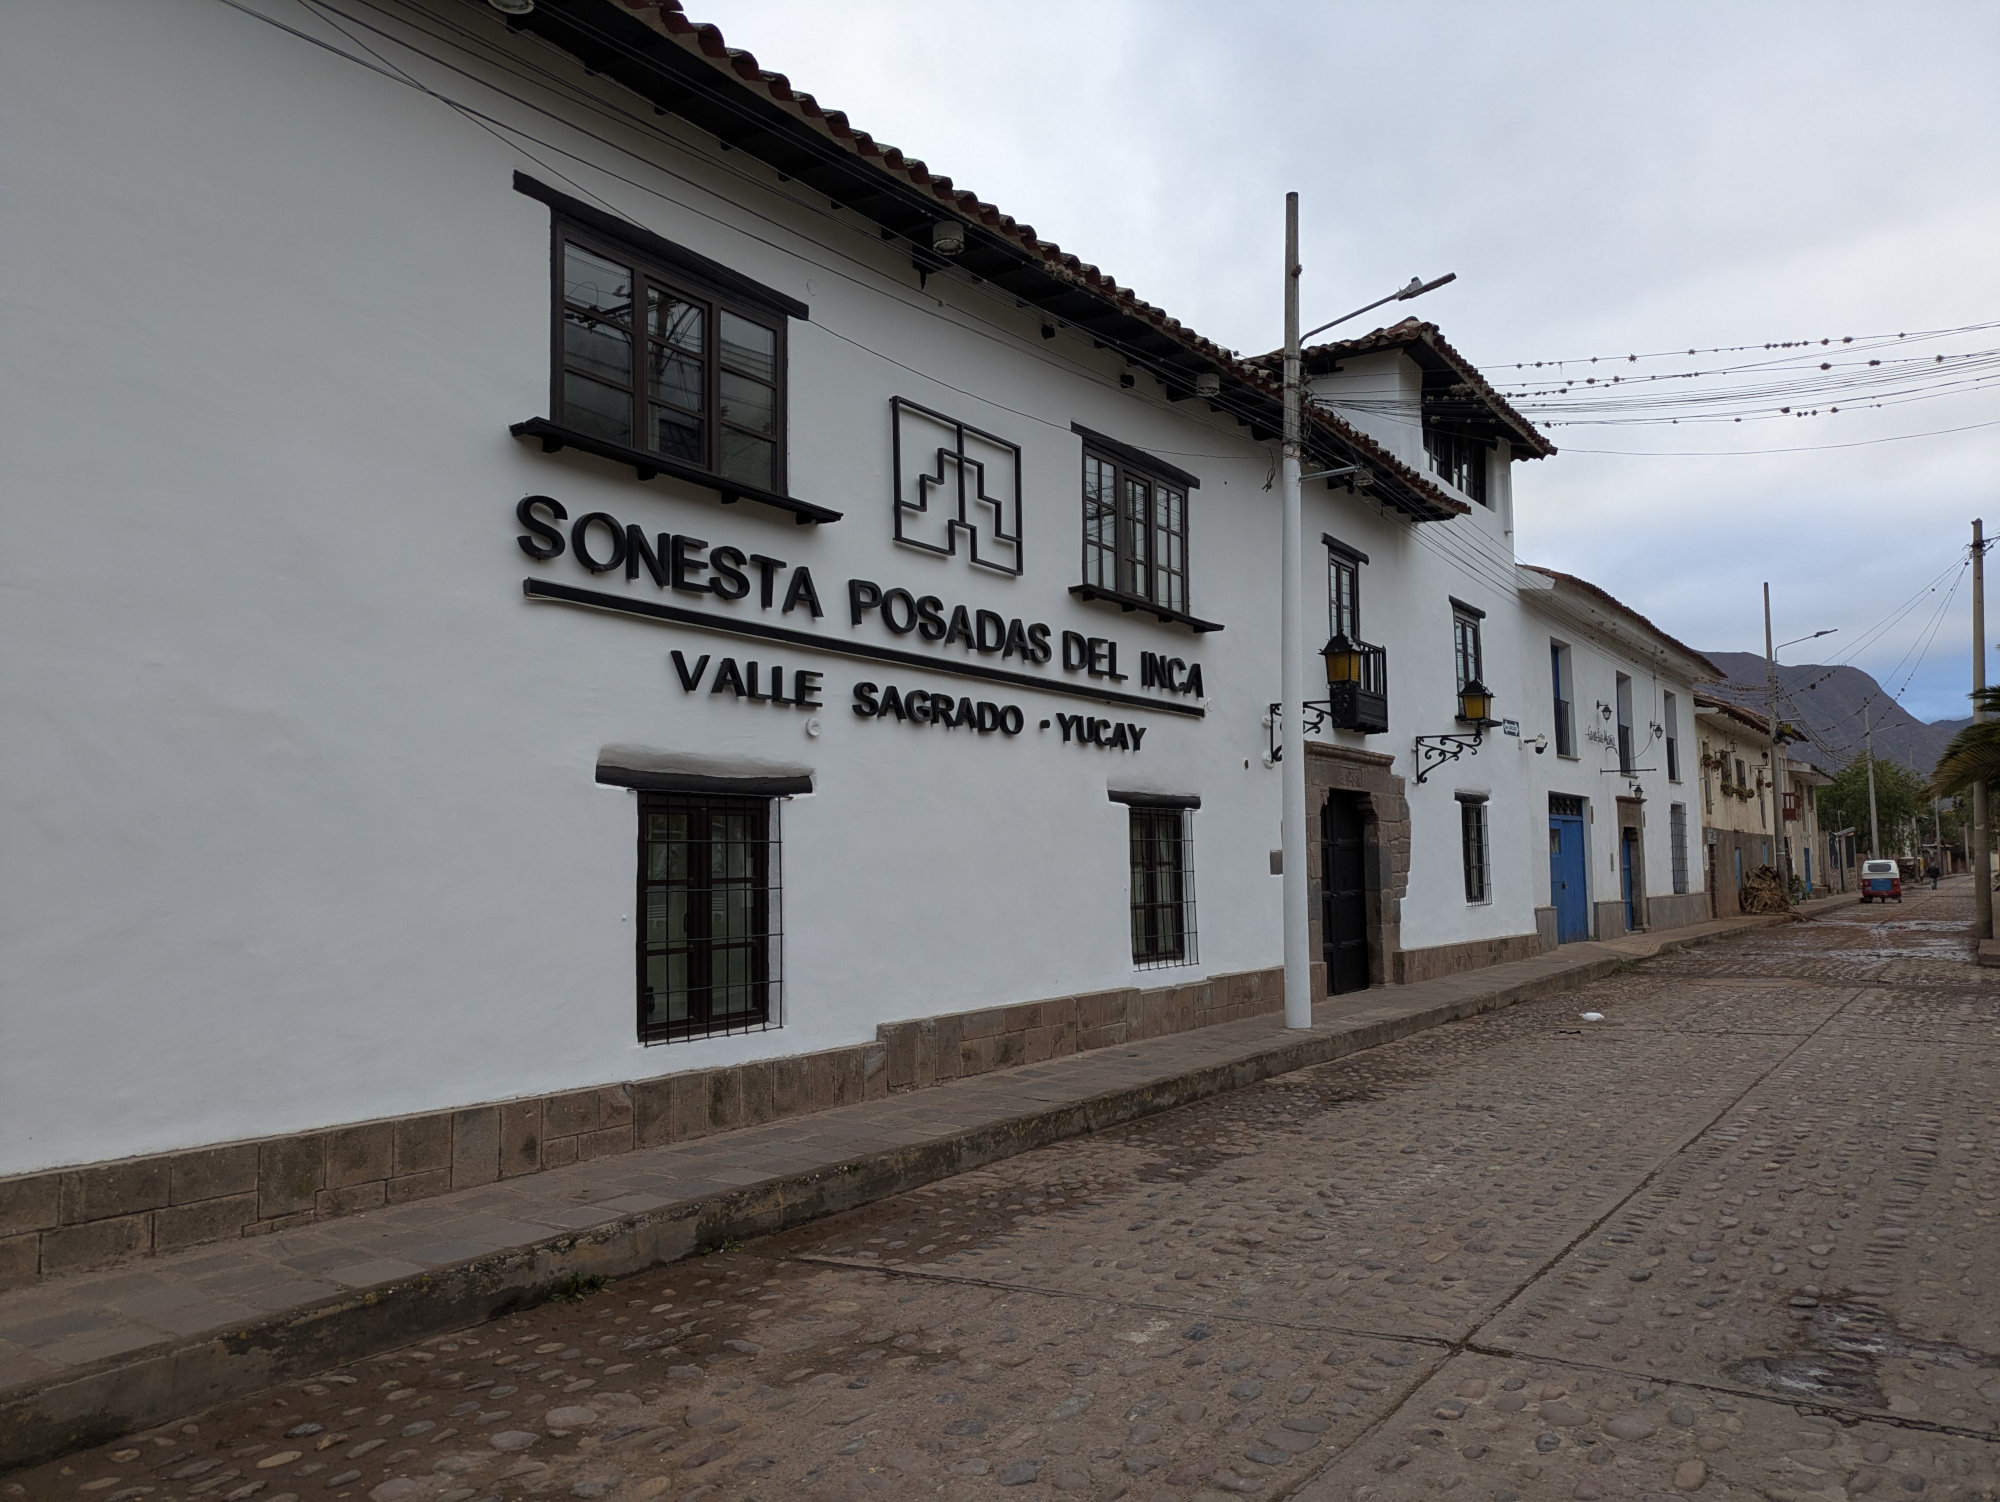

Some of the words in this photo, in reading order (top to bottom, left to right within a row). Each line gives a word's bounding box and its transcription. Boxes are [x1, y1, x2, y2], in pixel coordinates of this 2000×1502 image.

[517, 495, 824, 618] SONESTA
[849, 579, 1052, 665] POSADAS
[1062, 630, 1129, 681] DEL
[1141, 651, 1205, 698] INCA
[670, 650, 824, 708] VALLE
[852, 682, 1024, 735] SAGRADO
